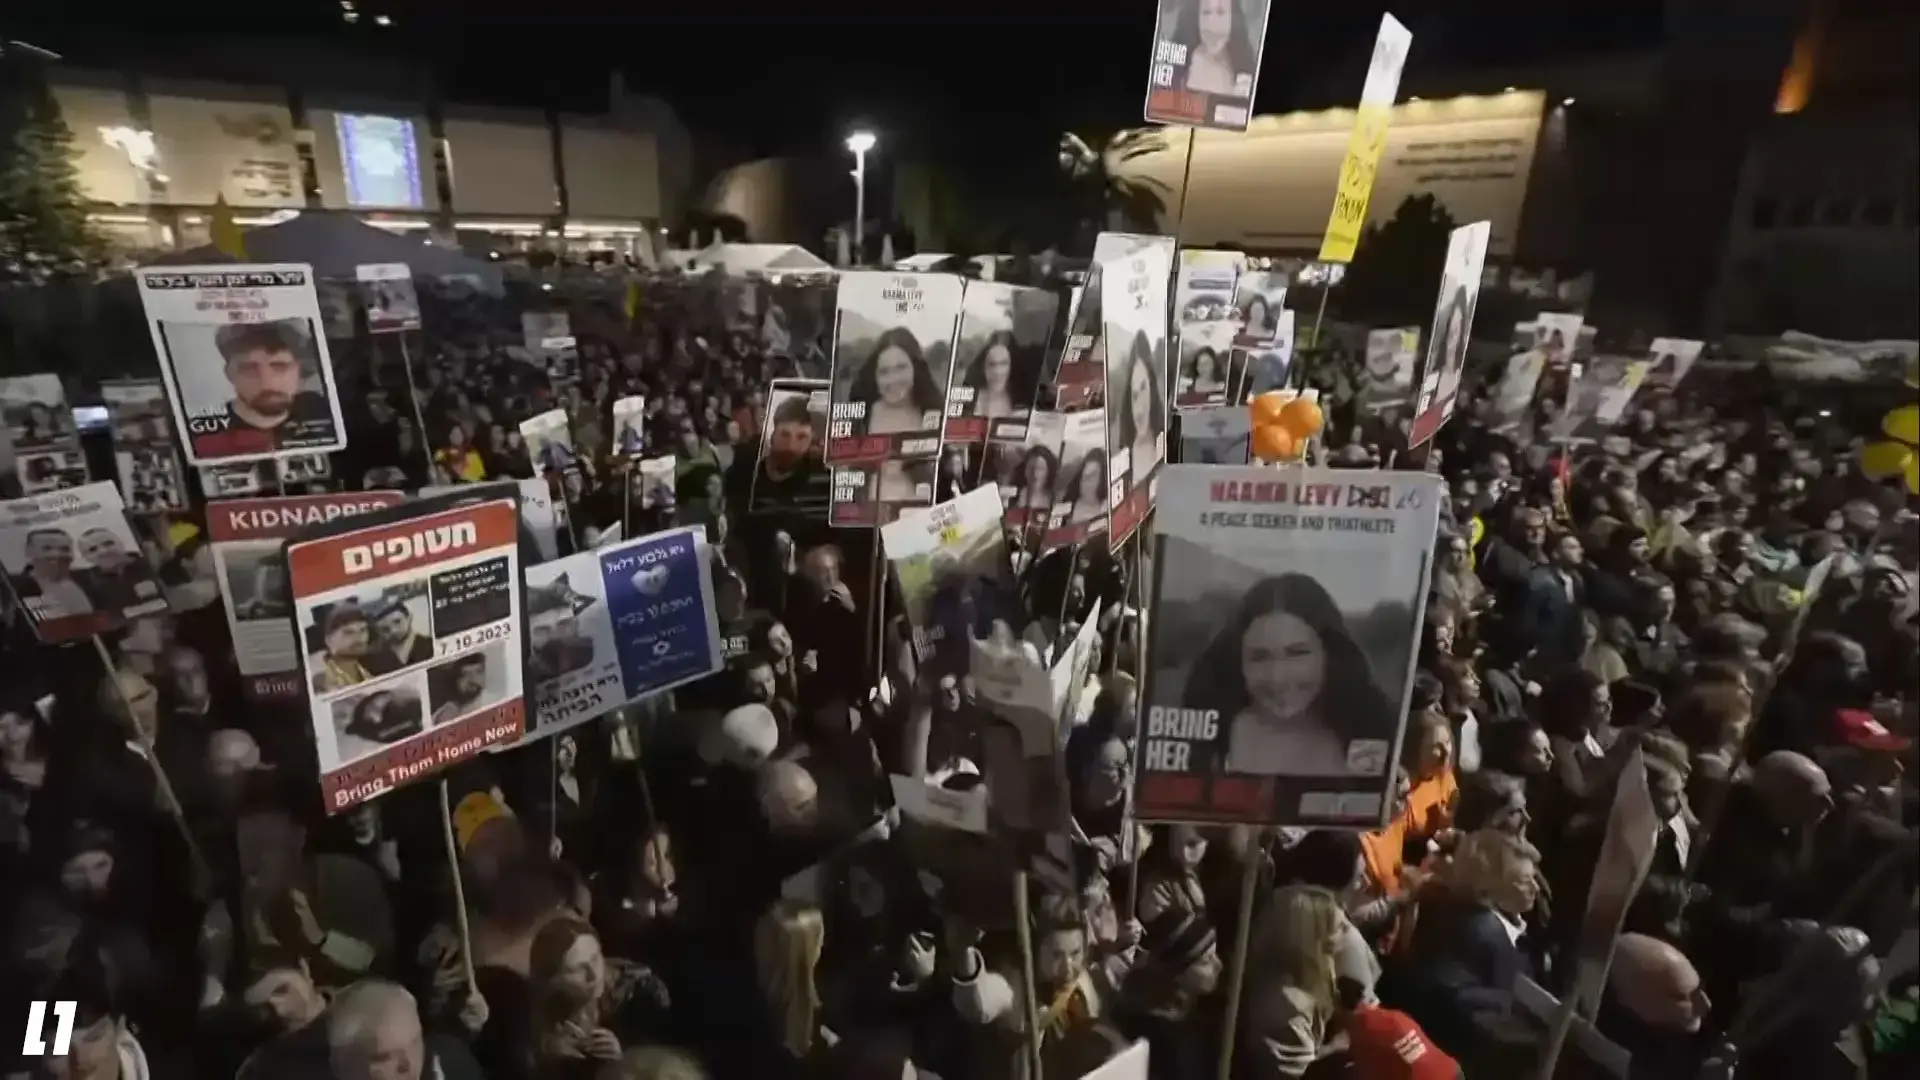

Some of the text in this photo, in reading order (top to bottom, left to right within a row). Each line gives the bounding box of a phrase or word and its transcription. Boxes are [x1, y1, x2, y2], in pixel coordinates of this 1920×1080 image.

[832, 401, 866, 420] BRING
[190, 418, 231, 433] GUY
[831, 420, 852, 438] HER
[1293, 485, 1342, 507] LEVY
[1210, 512, 1248, 528] PEACE
[1252, 513, 1298, 530] SEEKER
[1301, 516, 1324, 531] AND
[1327, 517, 1396, 534] TRIATHLETE
[341, 521, 476, 575] חטופים
[1149, 706, 1220, 740] BRING
[334, 721, 518, 807] Bring Them Home Now
[1145, 740, 1191, 772] HER
